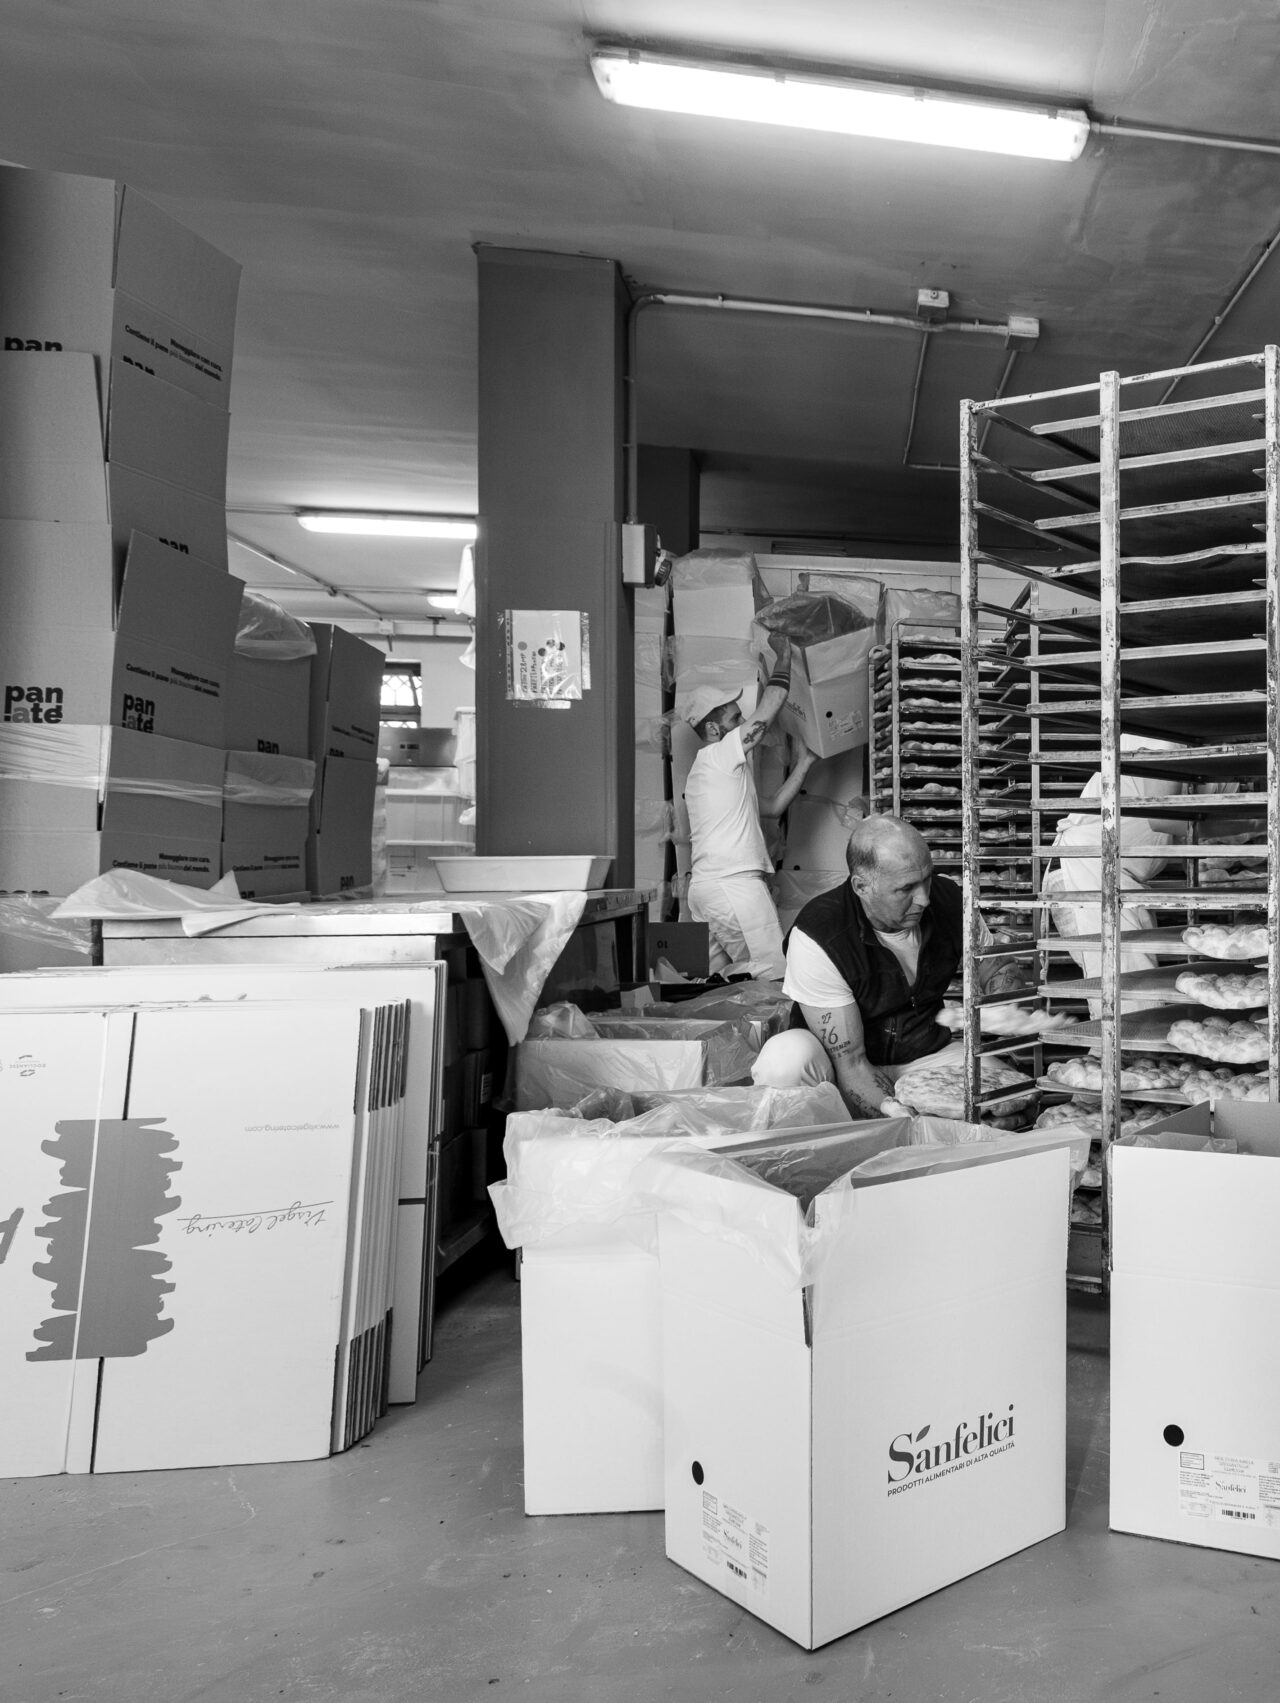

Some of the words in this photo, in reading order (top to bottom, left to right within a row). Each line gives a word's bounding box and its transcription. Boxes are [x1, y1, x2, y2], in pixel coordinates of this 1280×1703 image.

[4, 685, 64, 714] pan
[122, 693, 155, 721] pan
[887, 1404, 1015, 1484] Sanfelici
[887, 1478, 926, 1497] PRODOTTI
[925, 1461, 965, 1484] ALIMENTARI
[965, 1459, 973, 1467] DI
[973, 1452, 989, 1464] ALTA
